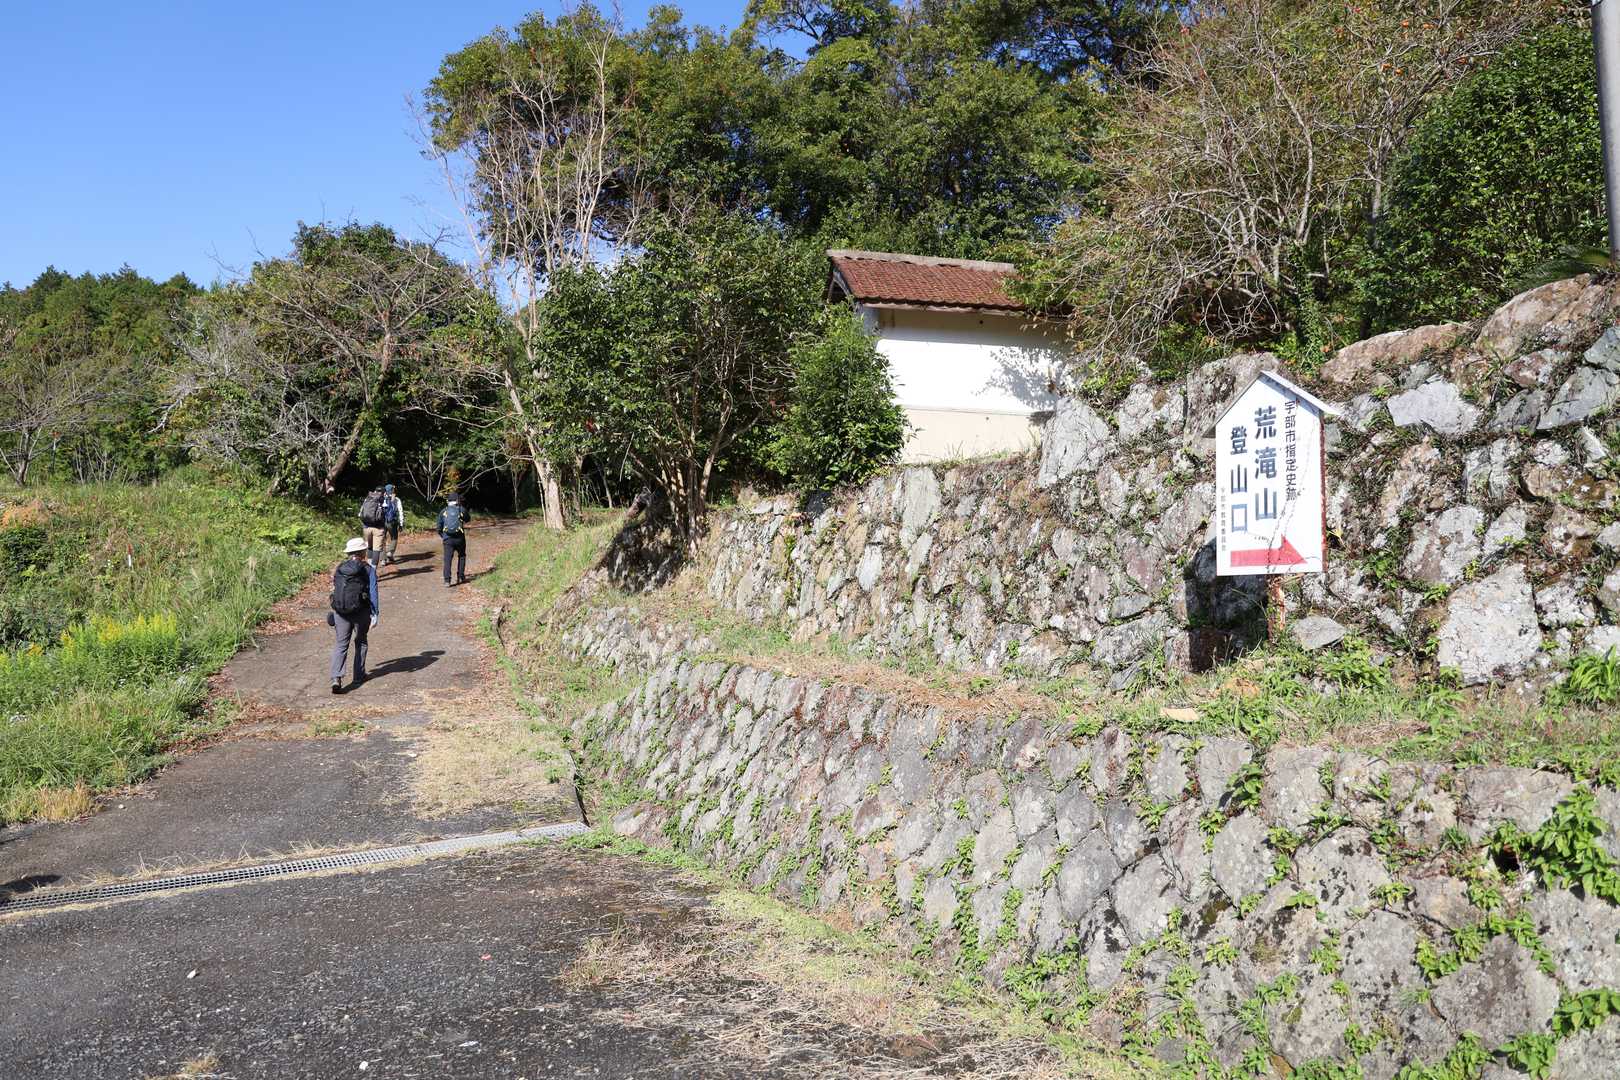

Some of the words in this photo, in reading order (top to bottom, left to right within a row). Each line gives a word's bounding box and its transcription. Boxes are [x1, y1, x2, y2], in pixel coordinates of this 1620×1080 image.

[1230, 425, 1247, 533] 登山口
[1254, 405, 1277, 520] 荒滝山
